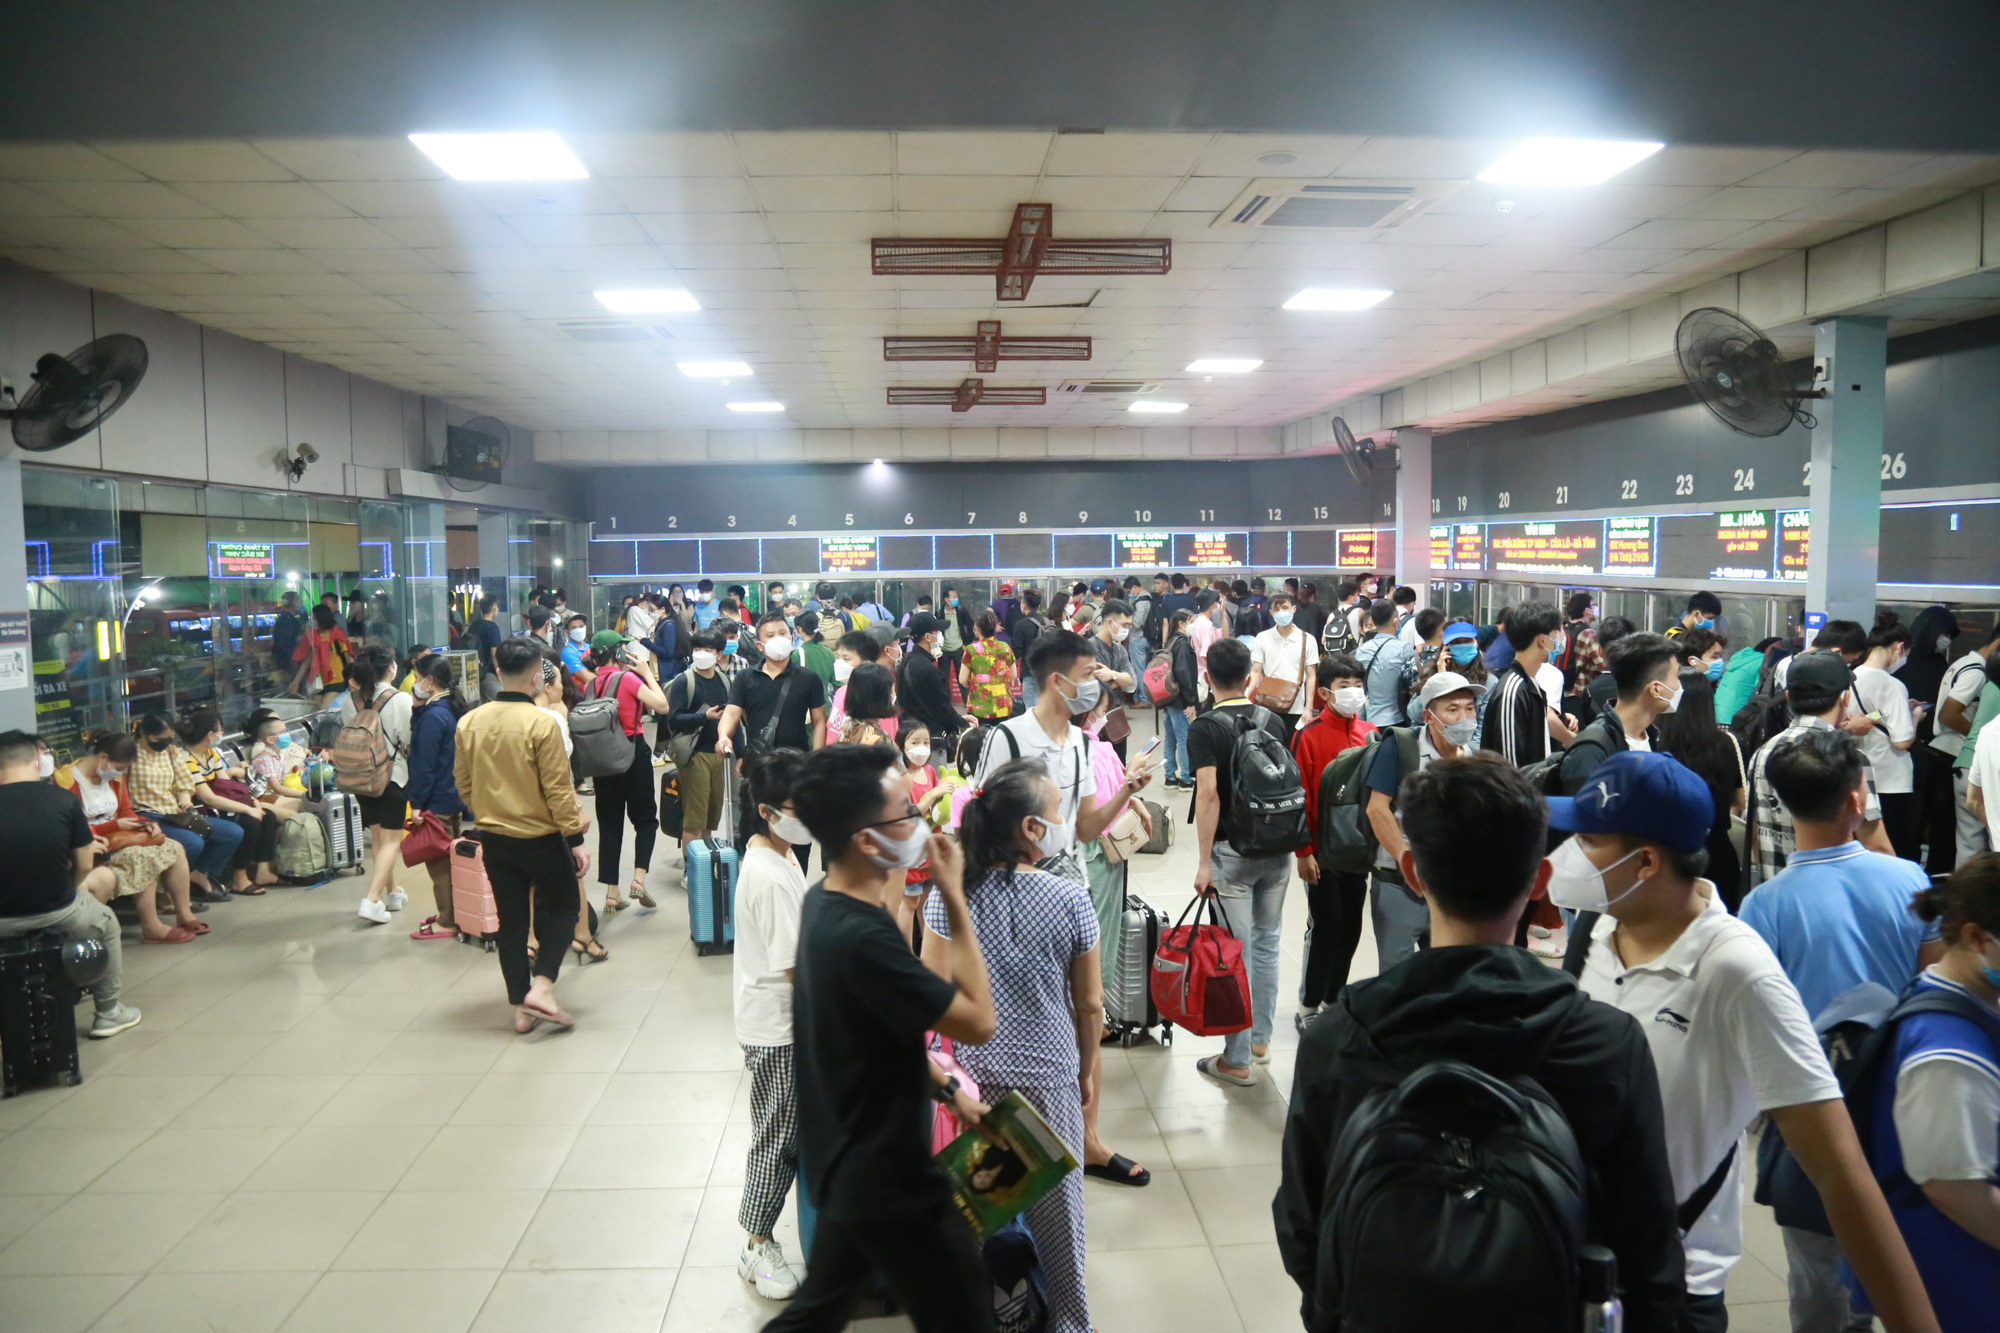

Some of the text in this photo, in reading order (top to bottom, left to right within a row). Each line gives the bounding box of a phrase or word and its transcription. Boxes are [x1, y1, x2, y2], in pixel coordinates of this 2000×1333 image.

[1880, 452, 1907, 480] 26
[1734, 468, 1754, 492] 24
[1803, 462, 1811, 486] 2
[1622, 480, 1638, 500] 22
[1676, 474, 1694, 496] 23
[1498, 492, 1510, 508] 20
[1556, 486, 1568, 504] 21
[1384, 503, 1392, 516] 16
[1432, 498, 1440, 514] 18
[1458, 496, 1468, 512] 19
[844, 513, 854, 526] 5
[904, 513, 914, 525] 6
[968, 512, 976, 525] 7
[1018, 512, 1028, 524] 8
[1078, 511, 1089, 523] 9
[1134, 510, 1152, 523] 10
[1200, 510, 1214, 522] 11
[1268, 508, 1282, 521] 12
[1314, 507, 1329, 520] 15
[610, 517, 616, 529] 1
[668, 516, 677, 528] 2
[728, 515, 737, 528] 3
[787, 514, 798, 527] 4
[1349, 545, 1370, 554] Friday
[43, 683, 56, 694] RA
[56, 682, 68, 692] XE
